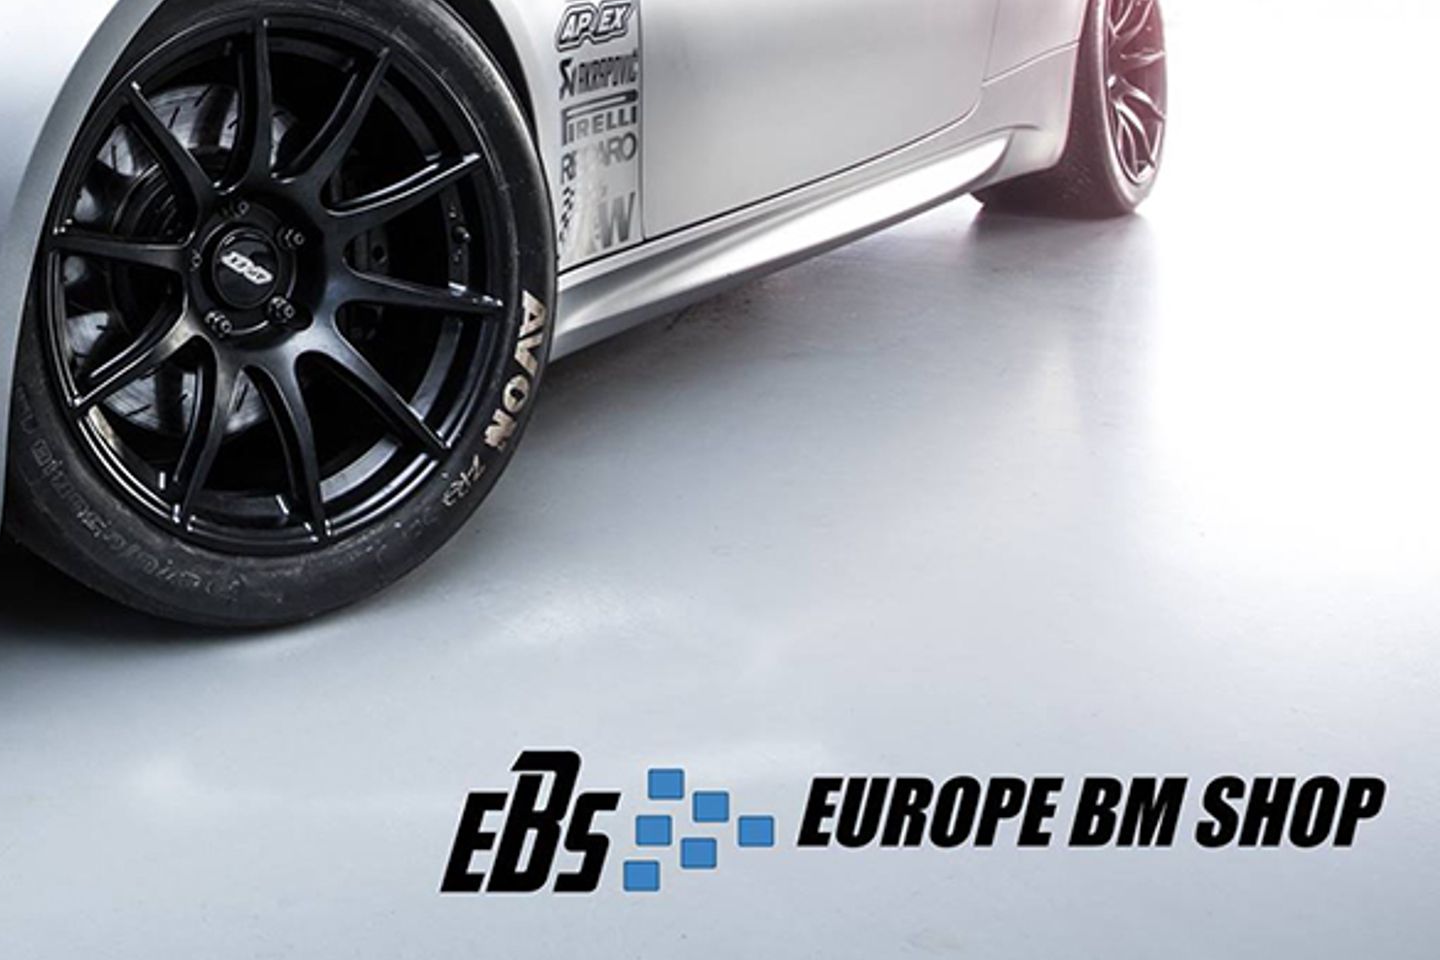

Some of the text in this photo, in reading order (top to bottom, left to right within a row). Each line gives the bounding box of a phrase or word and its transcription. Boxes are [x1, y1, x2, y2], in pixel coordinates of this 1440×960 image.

[559, 3, 630, 44] APEX
[561, 89, 638, 145] PIRELLI
[484, 290, 546, 451] AVON
